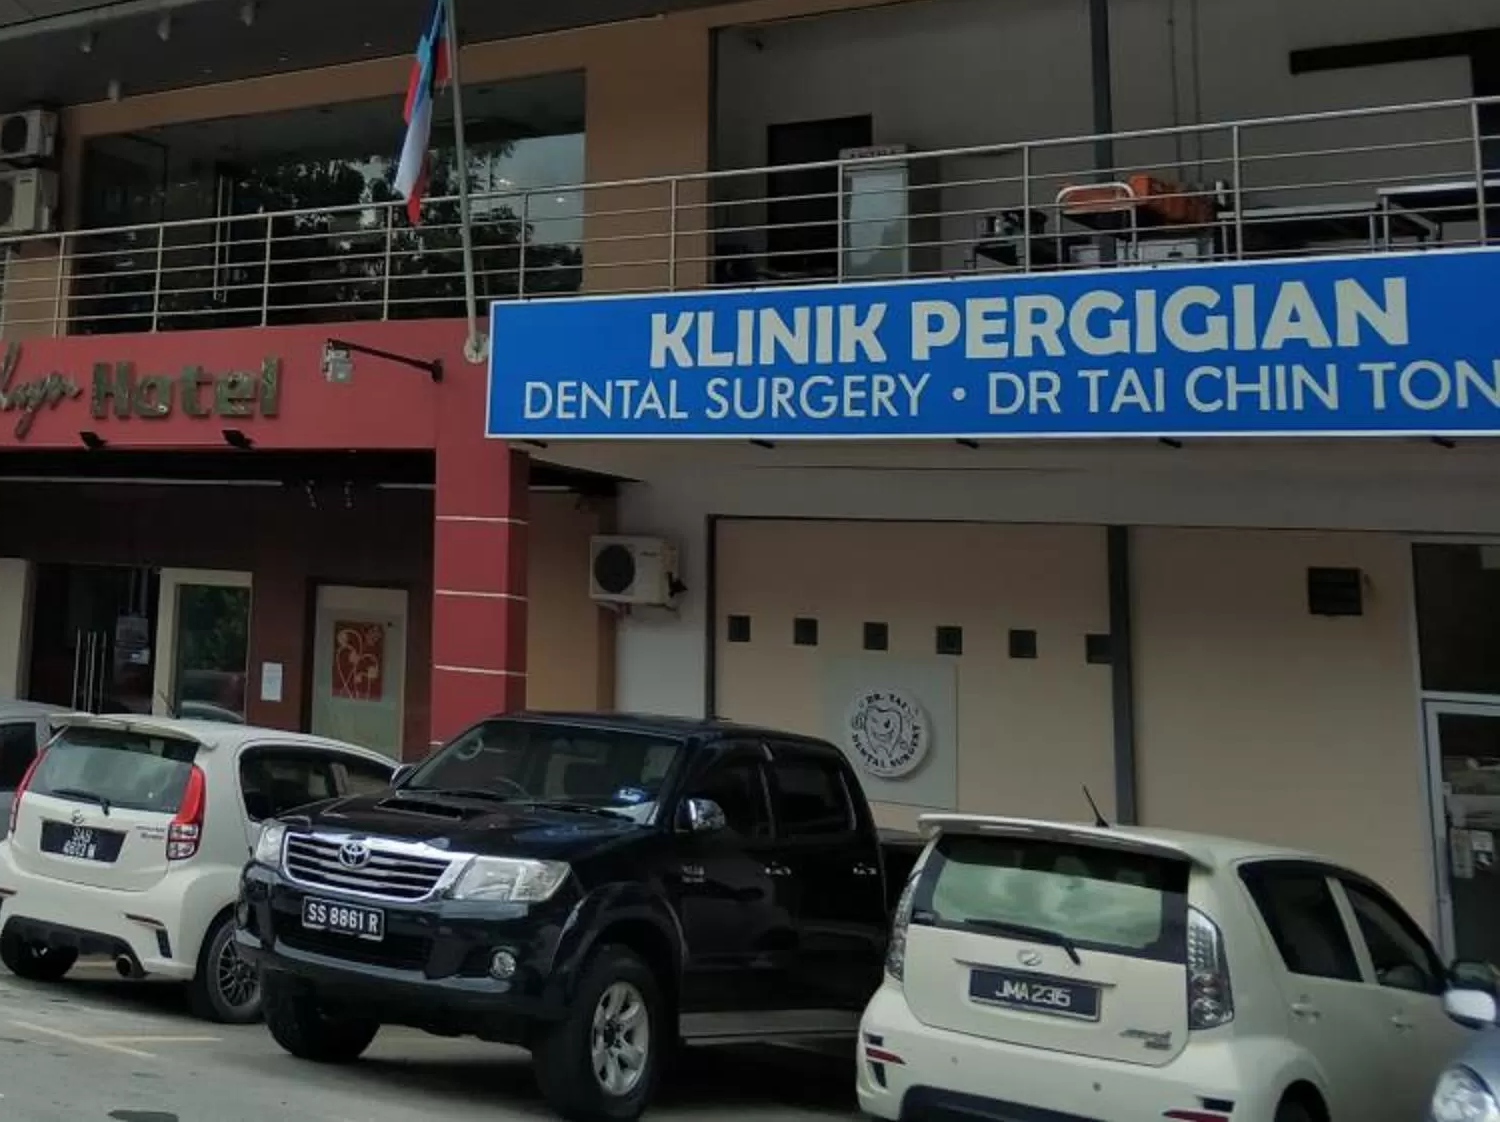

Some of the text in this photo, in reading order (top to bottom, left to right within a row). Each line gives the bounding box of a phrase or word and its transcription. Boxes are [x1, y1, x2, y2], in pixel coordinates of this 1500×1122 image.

[650, 277, 1409, 368] KLINIK PERGIGIAN
[90, 356, 285, 420] Hotel
[523, 379, 689, 420] DENTAL
[705, 373, 931, 419] SURGERY
[988, 371, 1062, 415] DR
[1078, 367, 1165, 414] TAI
[1186, 363, 1340, 412] CHIN
[308, 903, 379, 933] SS 8861 R
[995, 979, 1029, 1002] JMA
